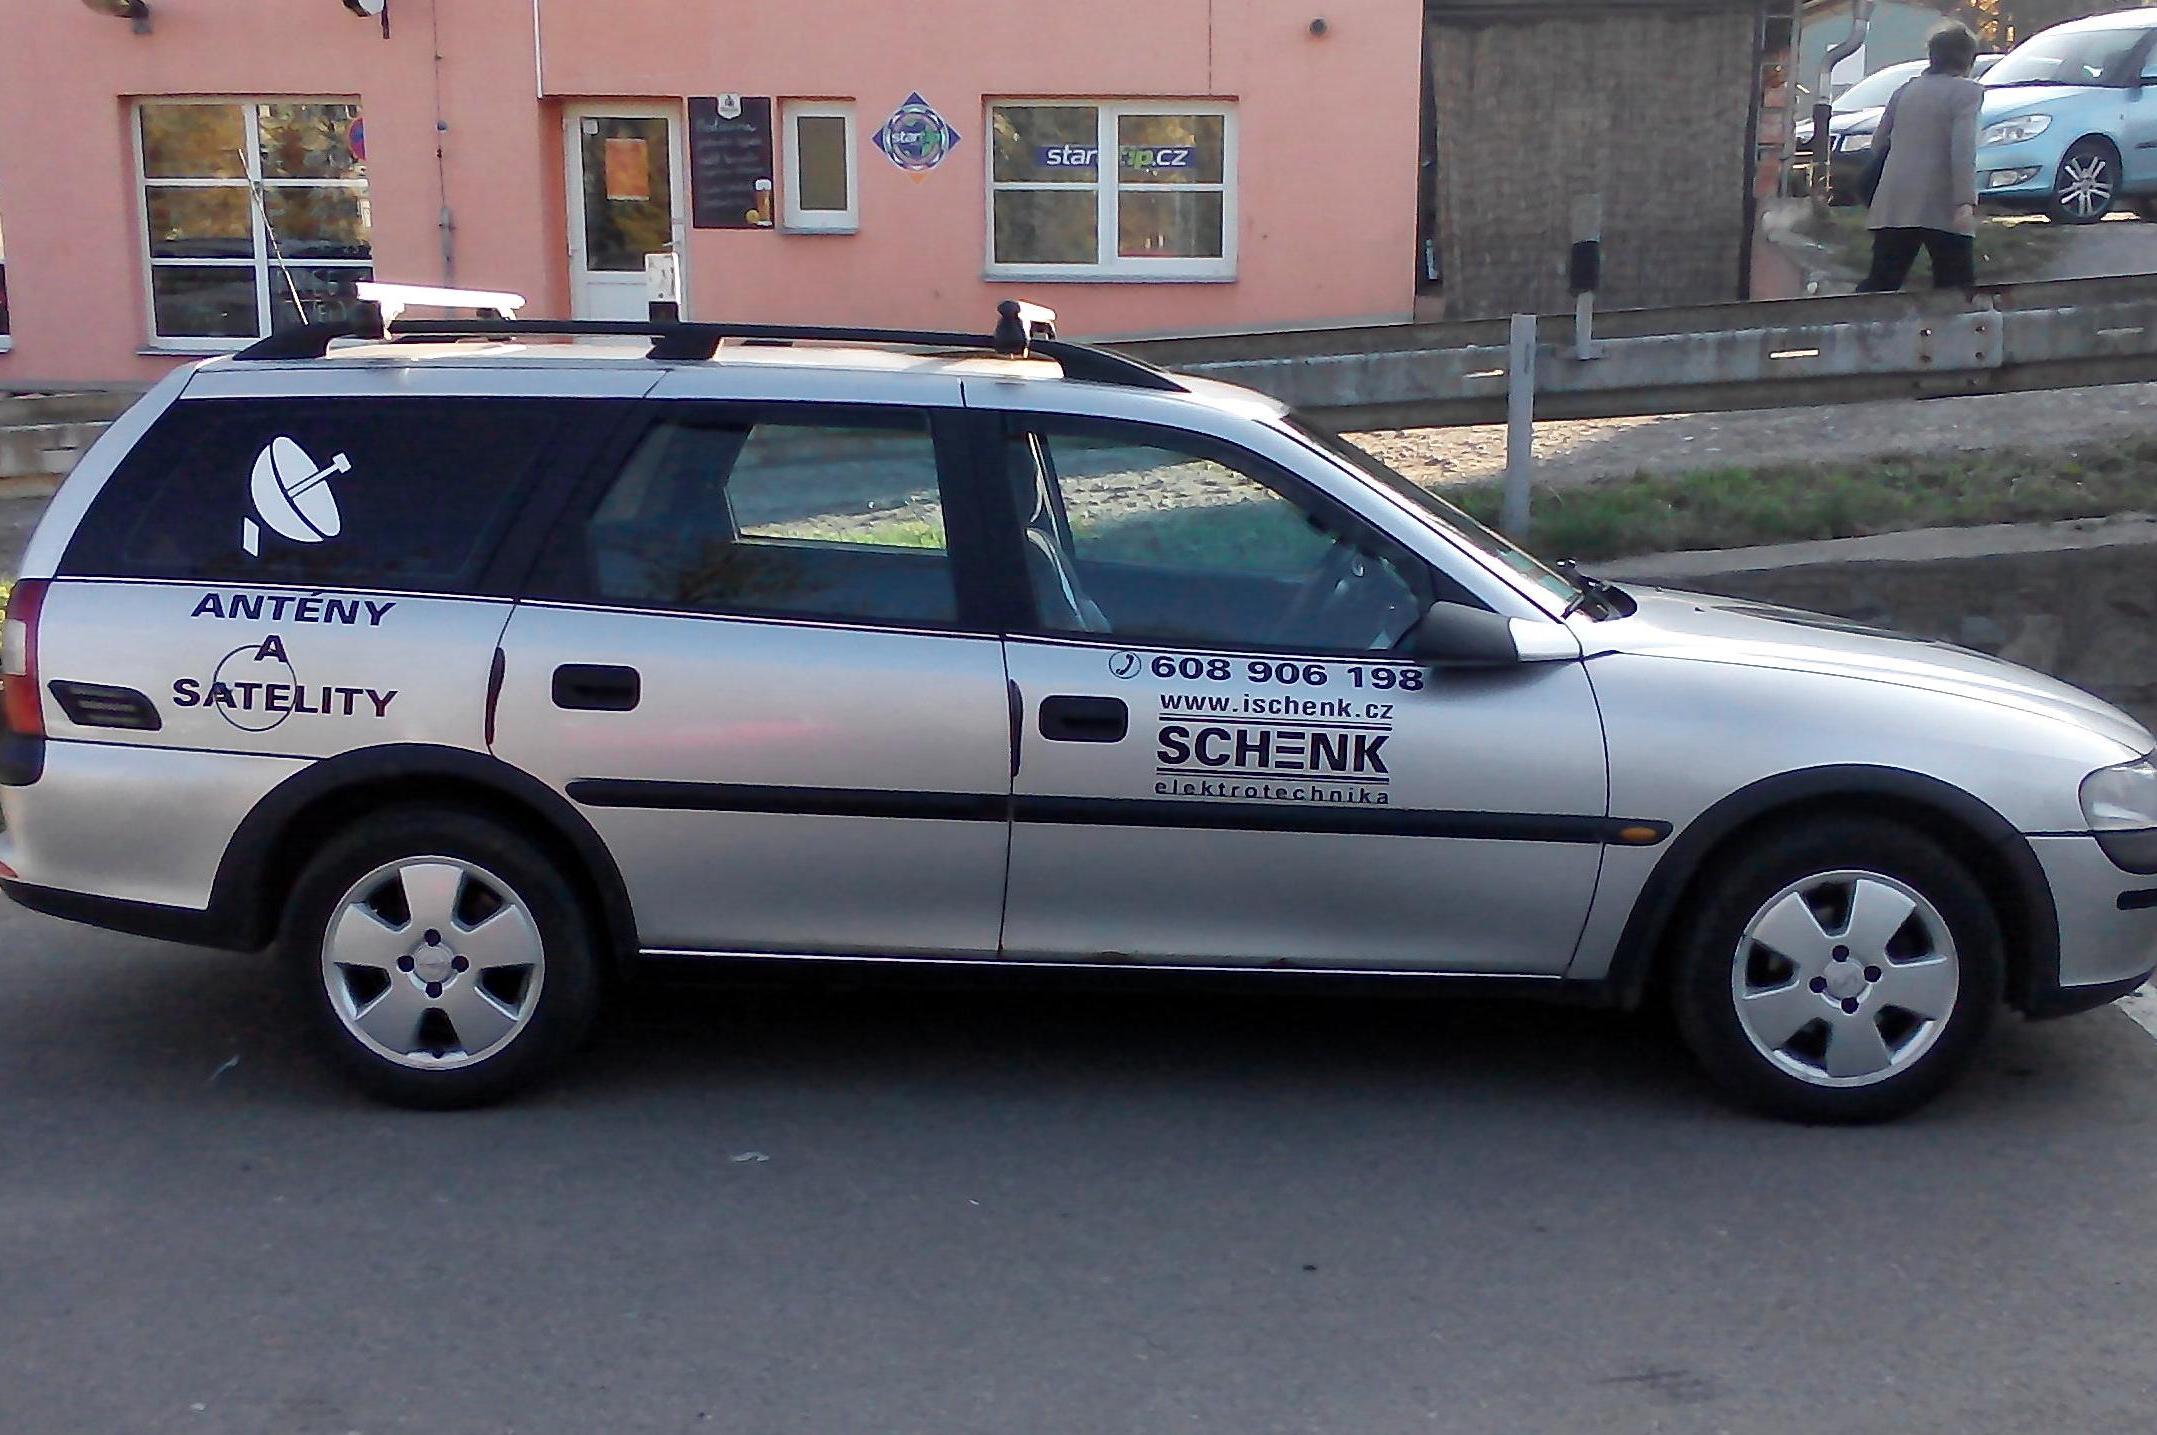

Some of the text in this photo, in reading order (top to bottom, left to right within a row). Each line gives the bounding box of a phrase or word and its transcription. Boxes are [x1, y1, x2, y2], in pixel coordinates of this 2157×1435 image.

[191, 591, 396, 626] ANTÉNY
[254, 634, 289, 663] A
[1151, 655, 1424, 691] 608 906 198
[172, 678, 399, 717] SATELITY
[1160, 694, 1394, 719] www.ischenk.cz
[1157, 725, 1390, 774] SCHENK
[1154, 780, 1390, 805] elektrotechnika
